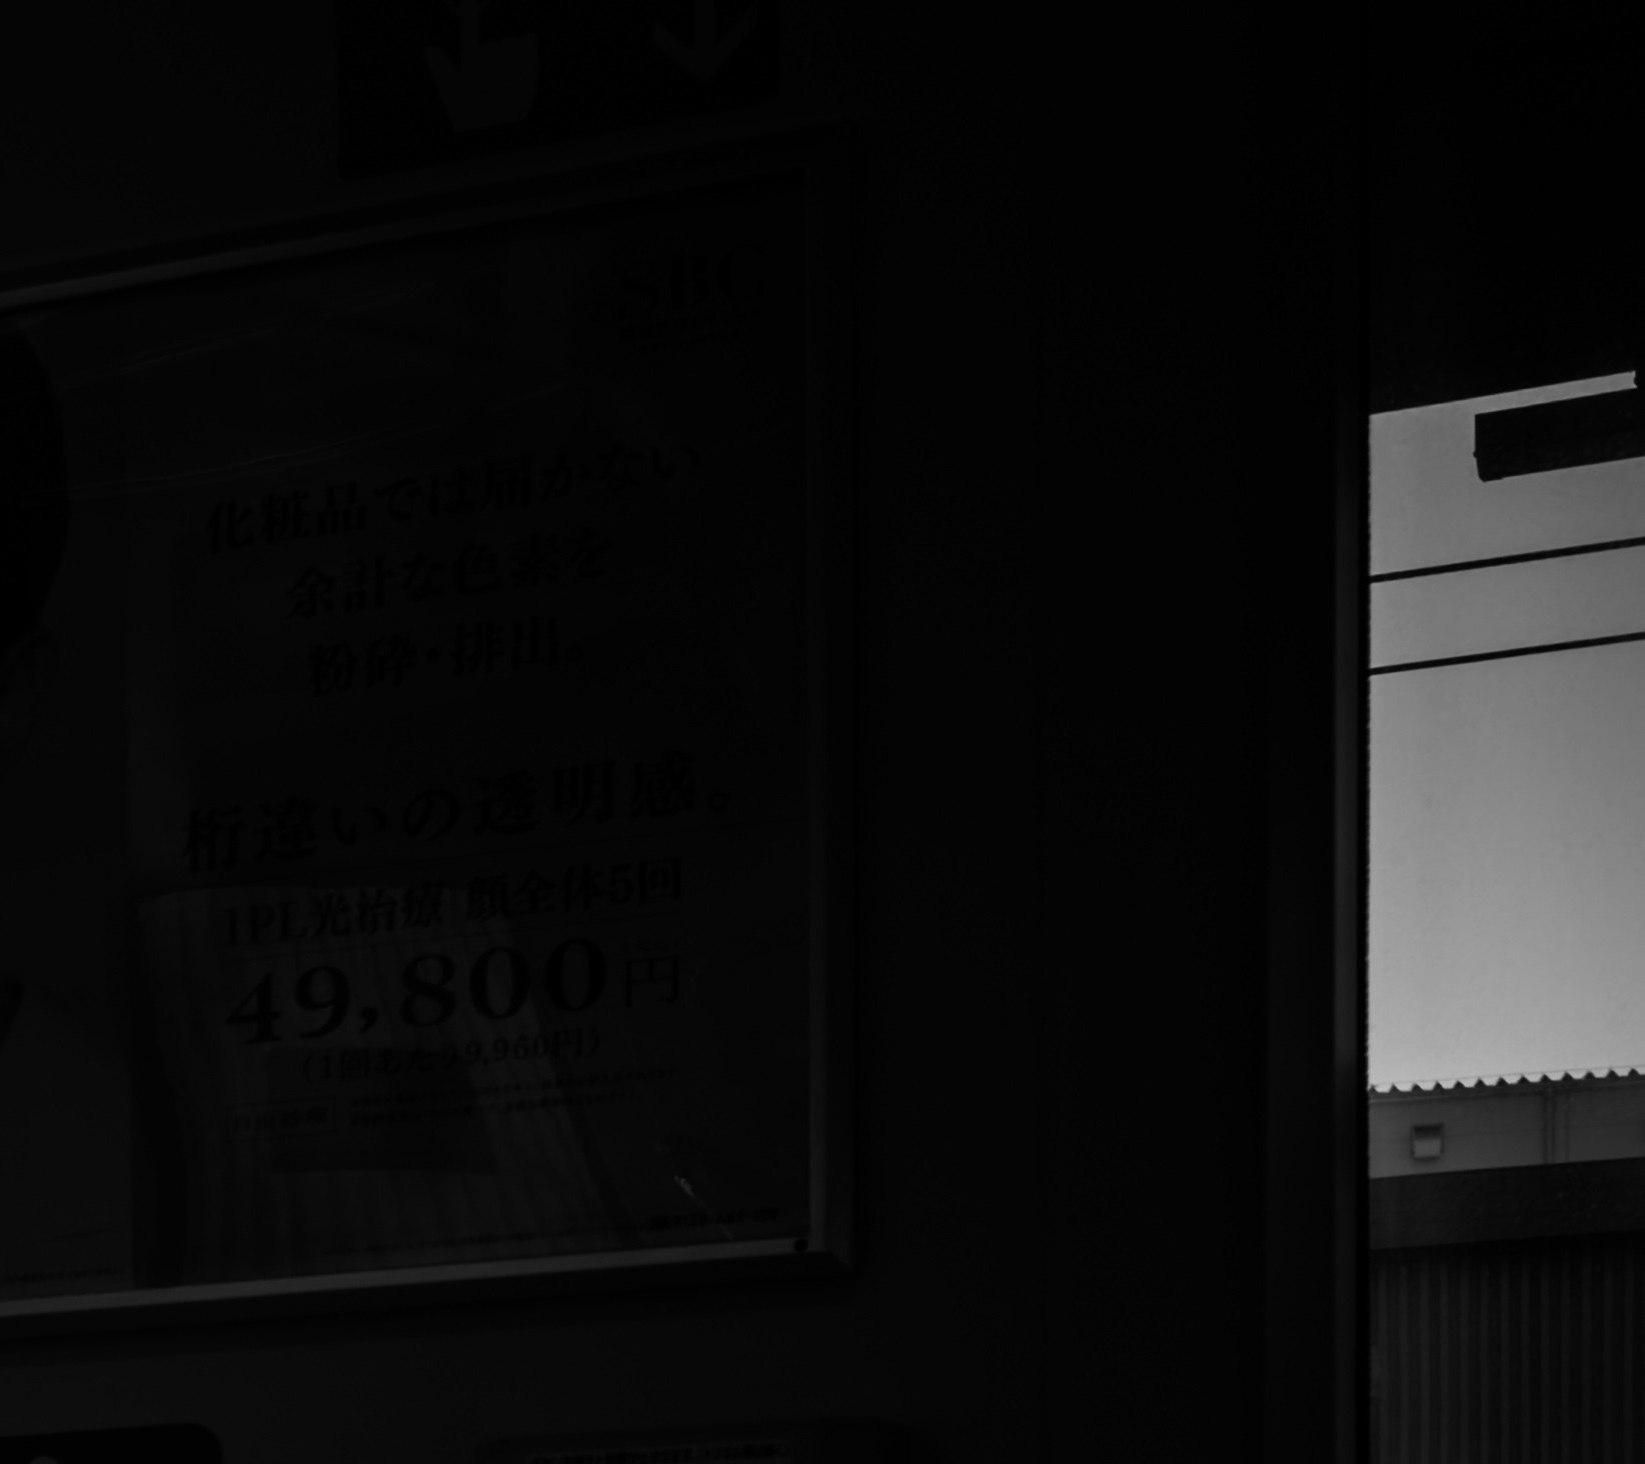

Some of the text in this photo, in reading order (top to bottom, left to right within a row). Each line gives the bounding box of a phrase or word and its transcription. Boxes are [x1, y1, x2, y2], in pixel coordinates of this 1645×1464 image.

[618, 241, 766, 319] SBC
[205, 441, 700, 554] 化粧品では届かない
[286, 527, 613, 620] 余計な色素を
[307, 615, 585, 697] 粉砕・排出。
[182, 749, 730, 872] 桁違いの透明感。
[225, 856, 682, 947] IPL光治療 顔全体5回
